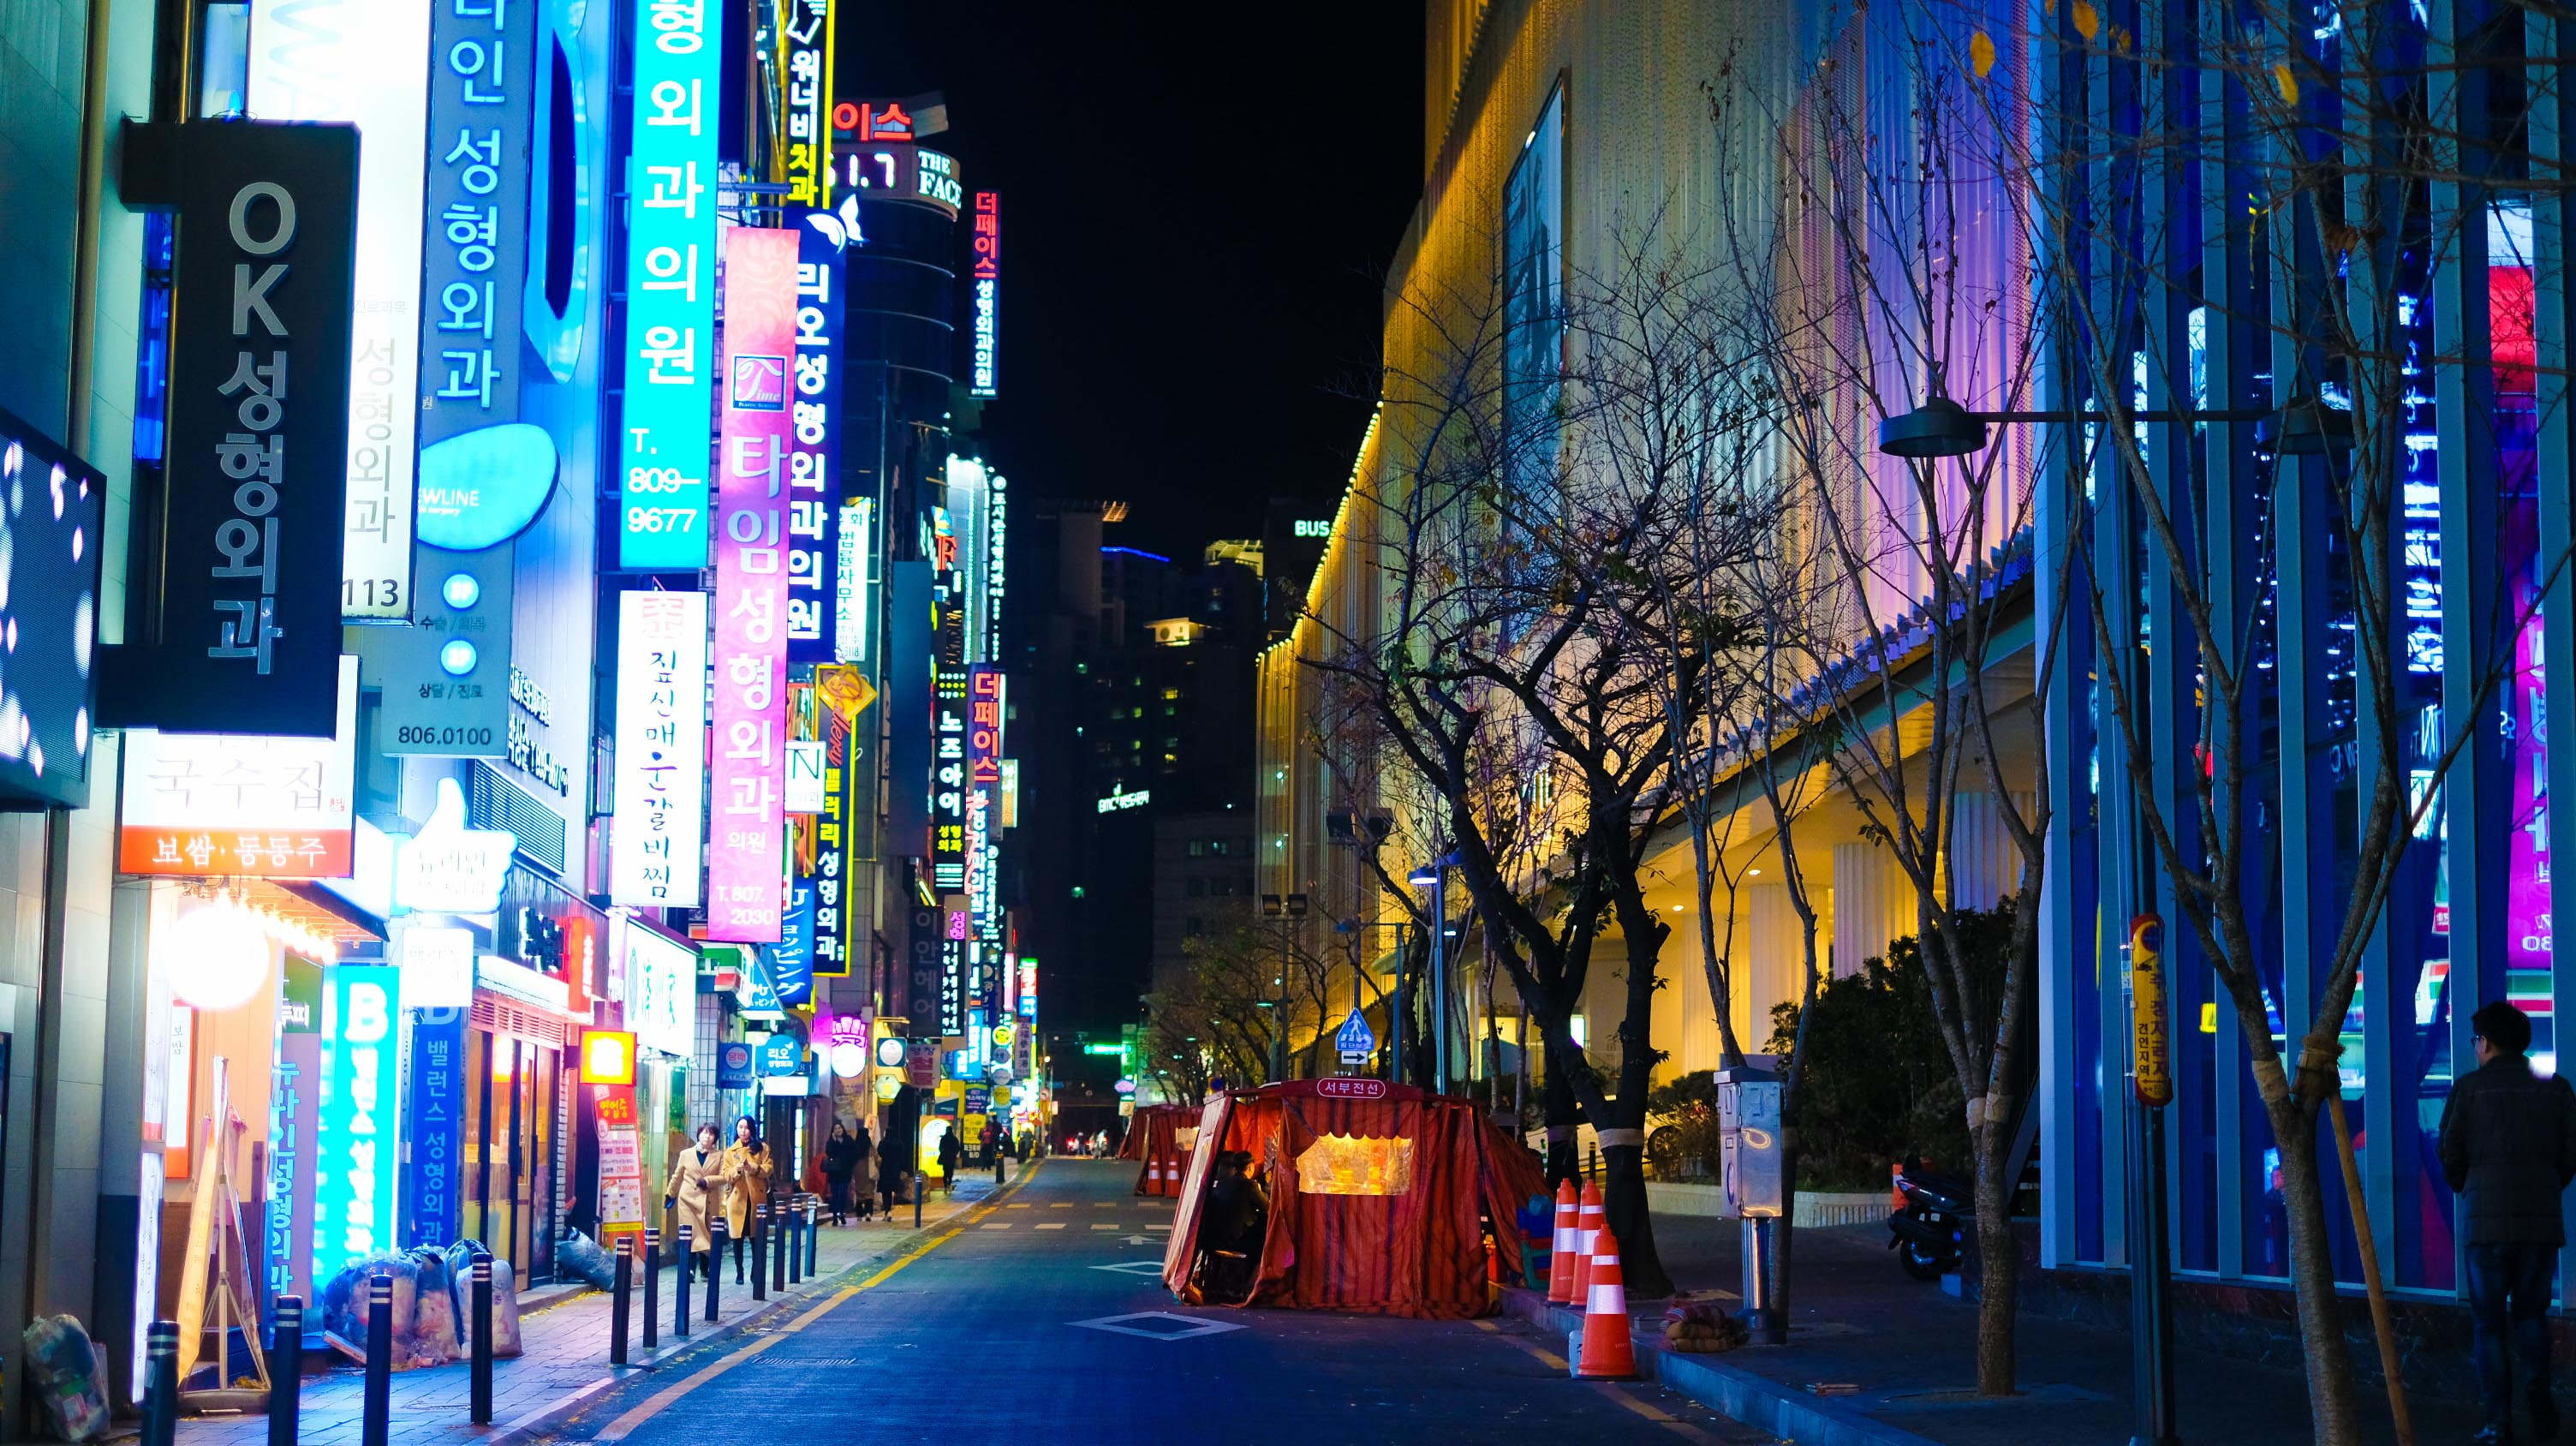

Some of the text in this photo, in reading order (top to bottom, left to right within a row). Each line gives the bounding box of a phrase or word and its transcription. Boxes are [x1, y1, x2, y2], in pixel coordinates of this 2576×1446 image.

[786, 50, 820, 207] 워너비 치과
[918, 150, 951, 175] THE
[641, 0, 704, 385] 형외과의원
[918, 170, 963, 210] FACE
[975, 193, 997, 278] 더페이스
[437, 128, 501, 408] 성형외과
[734, 357, 783, 402] Time
[348, 338, 396, 543] 성형외과
[630, 428, 658, 456] T.
[787, 264, 829, 640] 리오성형외과의원
[627, 507, 698, 534] 9677
[1295, 519, 1330, 537] BUS
[837, 531, 856, 621] 법률사무소
[397, 726, 492, 745] 806.0100
[973, 672, 1000, 781] 더페이스
[148, 758, 326, 811] 국수집
[939, 711, 963, 817] 노조아이
[727, 831, 766, 855] 의원
[731, 909, 774, 925] 2030
[914, 911, 940, 1023] 이안헤어
[344, 983, 389, 1043] B
[767, 1047, 790, 1061] 리오
[2138, 1023, 2150, 1076] 견인지역
[427, 1040, 447, 1121] 밸런스
[1325, 1082, 1378, 1095] 서부전선
[600, 1098, 628, 1119] 영업중
[420, 1132, 445, 1244] 성형외과
